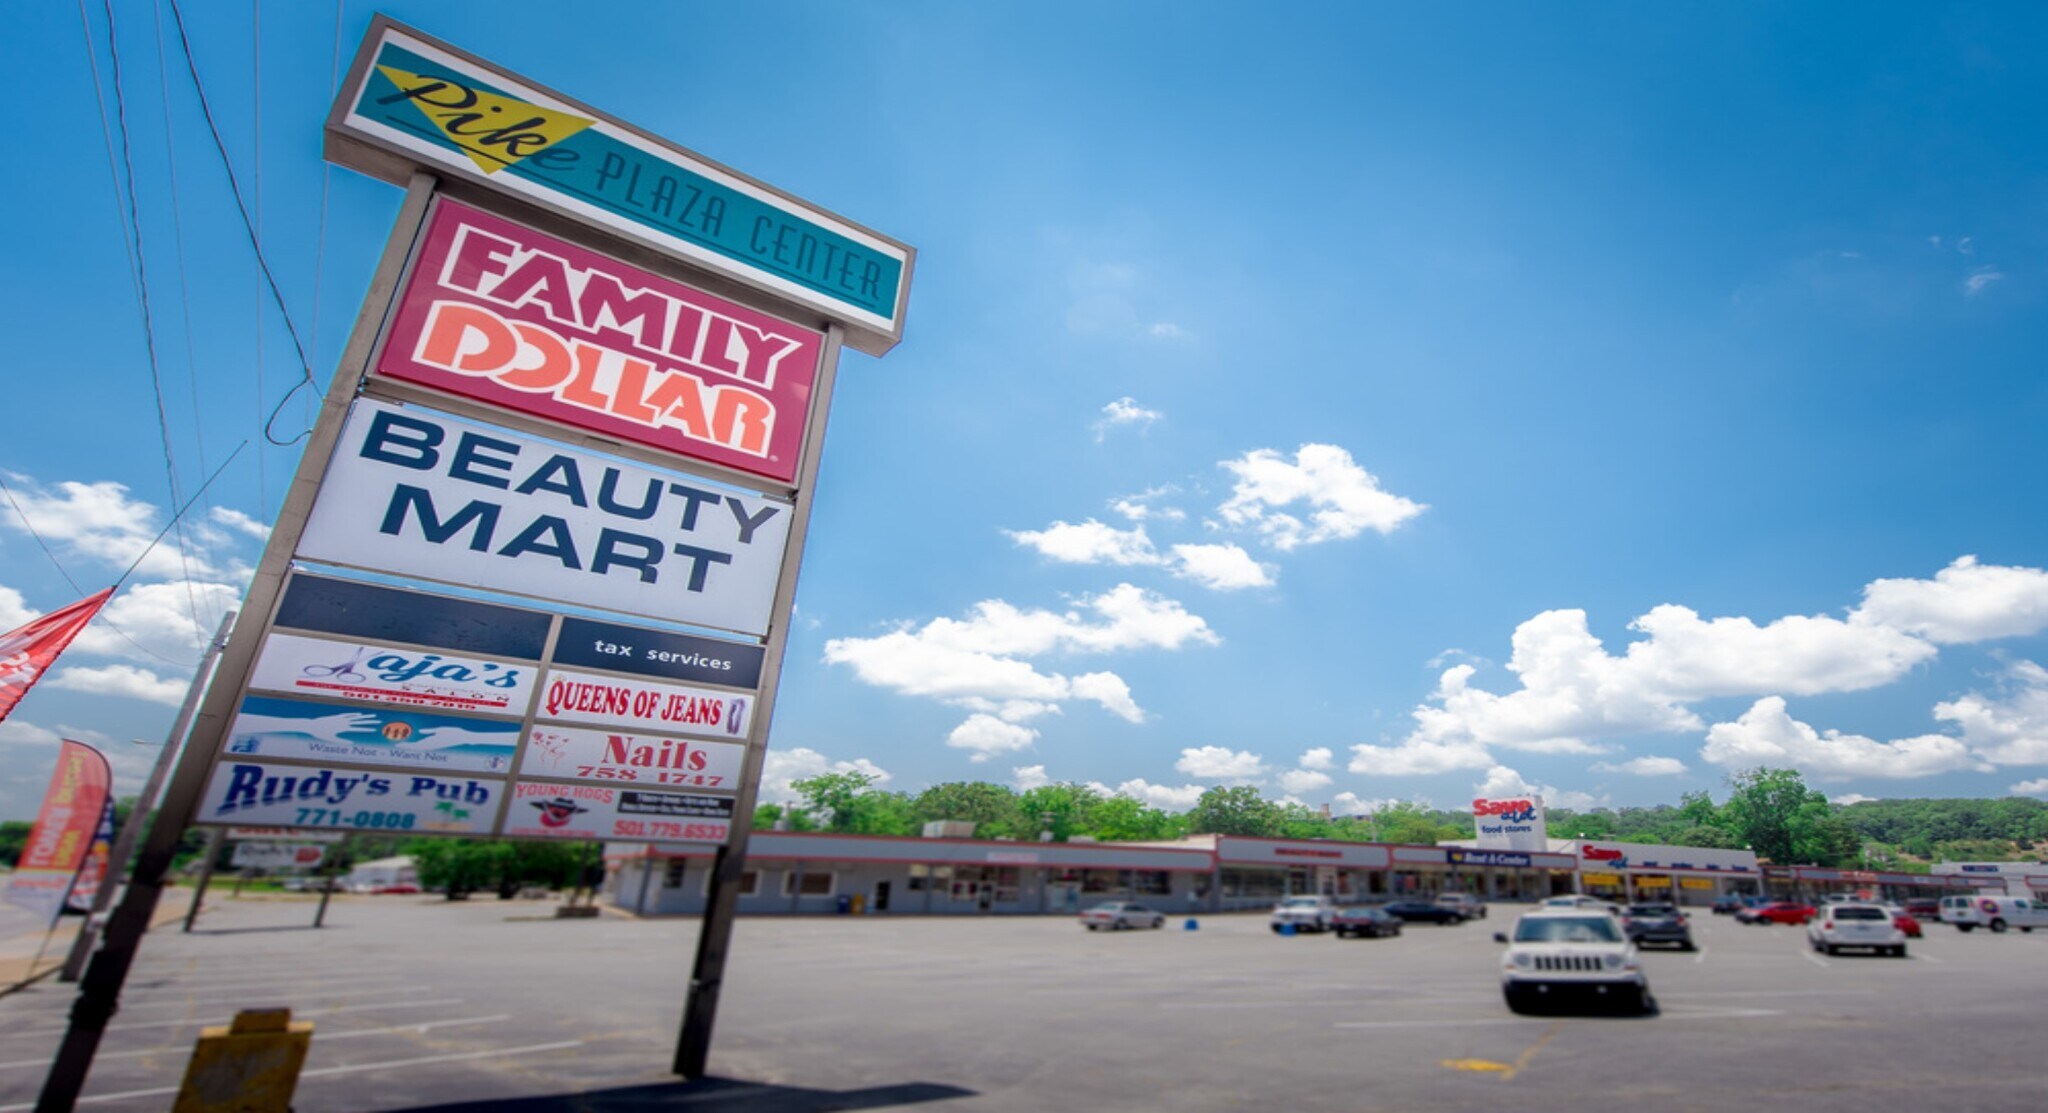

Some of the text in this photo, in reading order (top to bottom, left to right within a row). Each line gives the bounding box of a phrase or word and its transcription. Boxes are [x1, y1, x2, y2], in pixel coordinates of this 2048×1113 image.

[377, 74, 882, 302] Pike PLAZA CENTER
[437, 222, 803, 390] FAMILY
[411, 299, 777, 458] DOLLAR
[359, 410, 781, 545] BEAUTY
[379, 482, 733, 593] MART
[367, 654, 519, 688] aja's
[594, 640, 732, 671] tax services
[545, 680, 631, 715] QUEENS
[633, 690, 661, 719] OF
[660, 693, 723, 726] JEANS
[310, 743, 348, 754] Waste
[351, 745, 377, 756] Not
[389, 749, 422, 760] Want
[424, 751, 448, 762] Not
[601, 735, 707, 771] Nails
[216, 764, 490, 816] Rudy's Pub
[515, 783, 569, 802] YOUNG
[1473, 798, 1532, 816] Save
[295, 807, 417, 830] 771-0808
[1482, 825, 1502, 834] food
